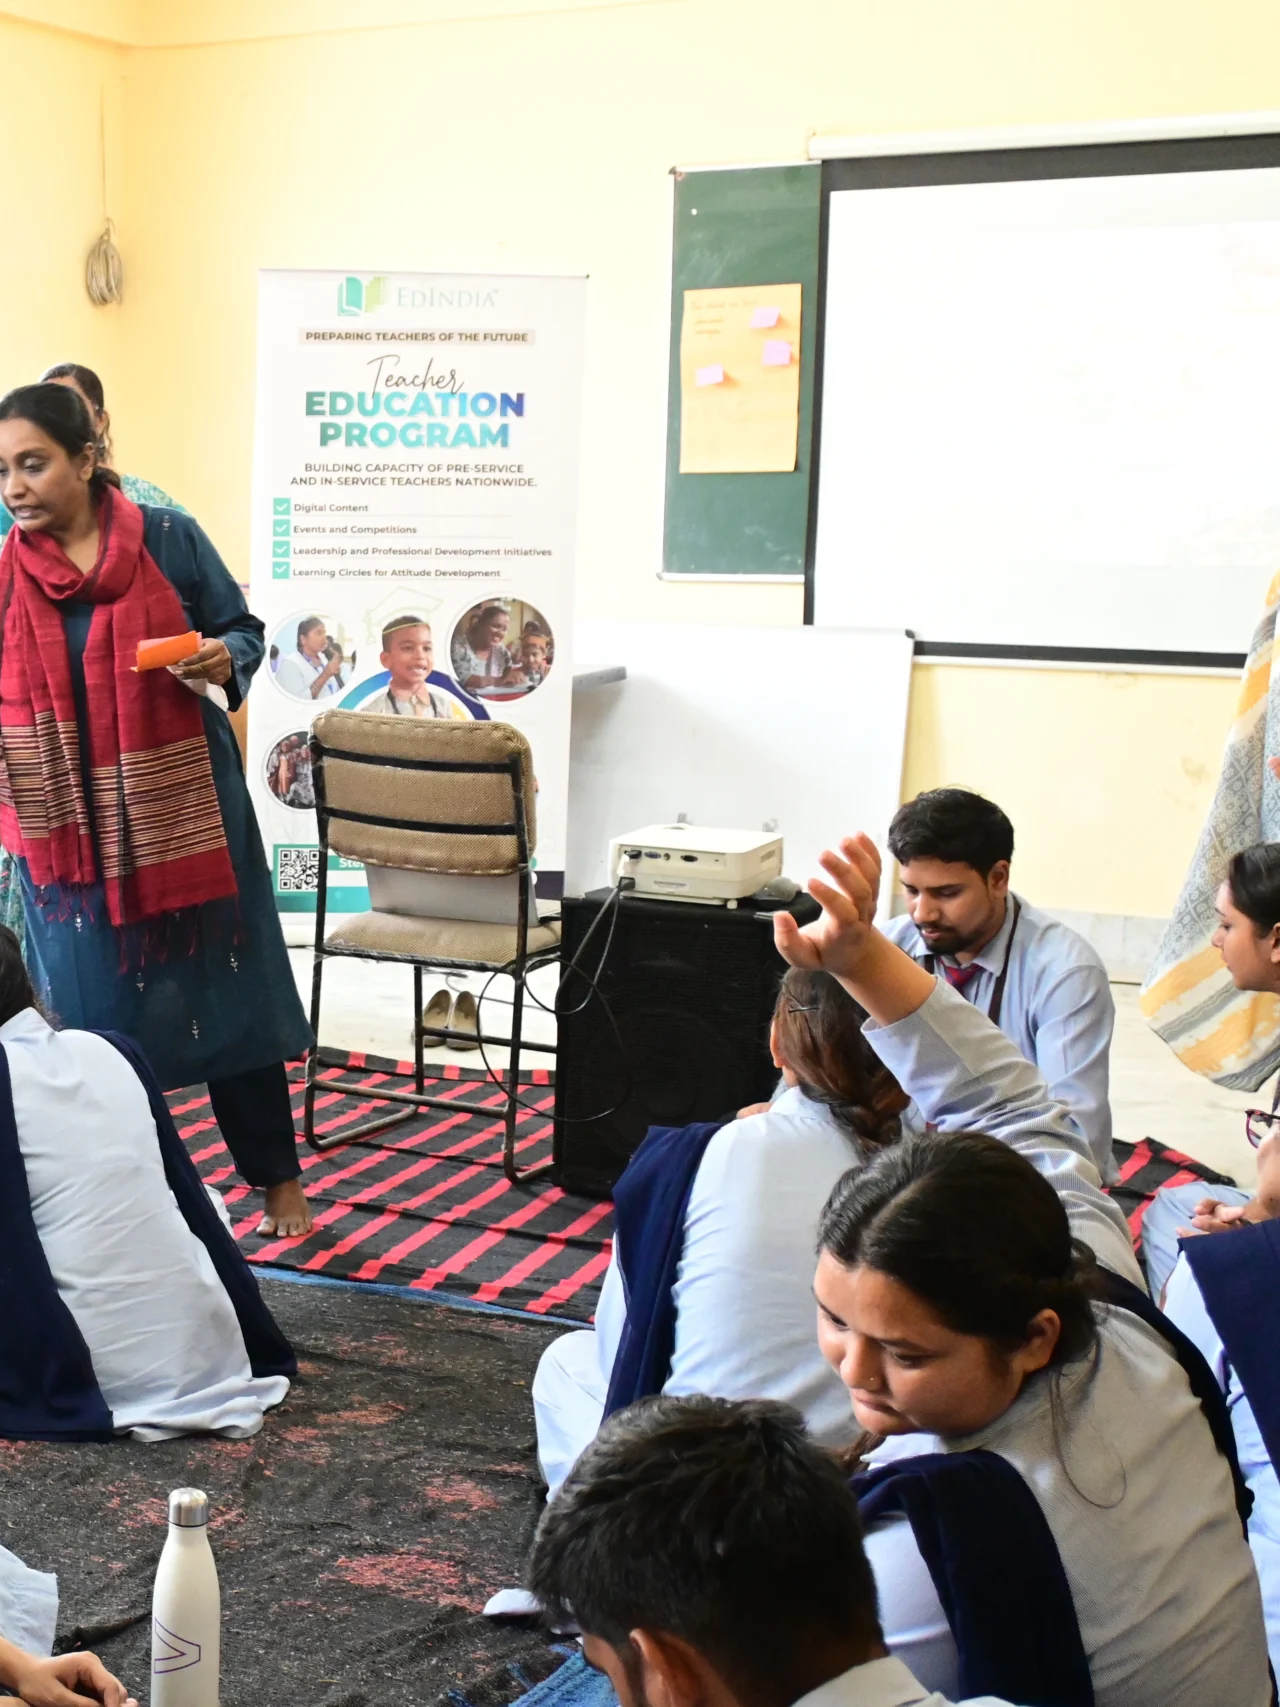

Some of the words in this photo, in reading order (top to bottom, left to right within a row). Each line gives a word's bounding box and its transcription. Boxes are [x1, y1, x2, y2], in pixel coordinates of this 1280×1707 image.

[305, 331, 372, 341] PREPARING
[375, 332, 436, 342] TEACHERS
[438, 332, 454, 342] OF
[457, 332, 480, 342] THE
[483, 332, 528, 342] FUTURE
[366, 354, 465, 399] Teacher
[305, 391, 525, 417] EDUCATION
[319, 422, 510, 448] PROGRAM
[304, 463, 362, 473] BUILDING
[365, 463, 424, 473] CAPACITY
[427, 463, 443, 473] OF
[446, 463, 524, 474] PRE-SERVICE
[290, 476, 318, 486] AND
[320, 476, 387, 486] IN-SERVICE
[390, 476, 452, 487] TEACHERS
[455, 477, 537, 487] NATIONWIDE.
[293, 503, 327, 514] Digital
[328, 503, 369, 512] Content
[293, 525, 325, 534] Events
[329, 525, 348, 534] and
[350, 525, 418, 535] Competitions
[293, 546, 348, 557] Leadership
[349, 547, 370, 556] and
[371, 547, 433, 556] Professional
[434, 547, 501, 557] Development
[503, 548, 553, 557] Initiatives
[292, 568, 336, 579] Learning
[338, 568, 372, 577] Circles
[374, 568, 388, 577] for
[390, 568, 432, 577] Attitude
[434, 569, 501, 579] Development
